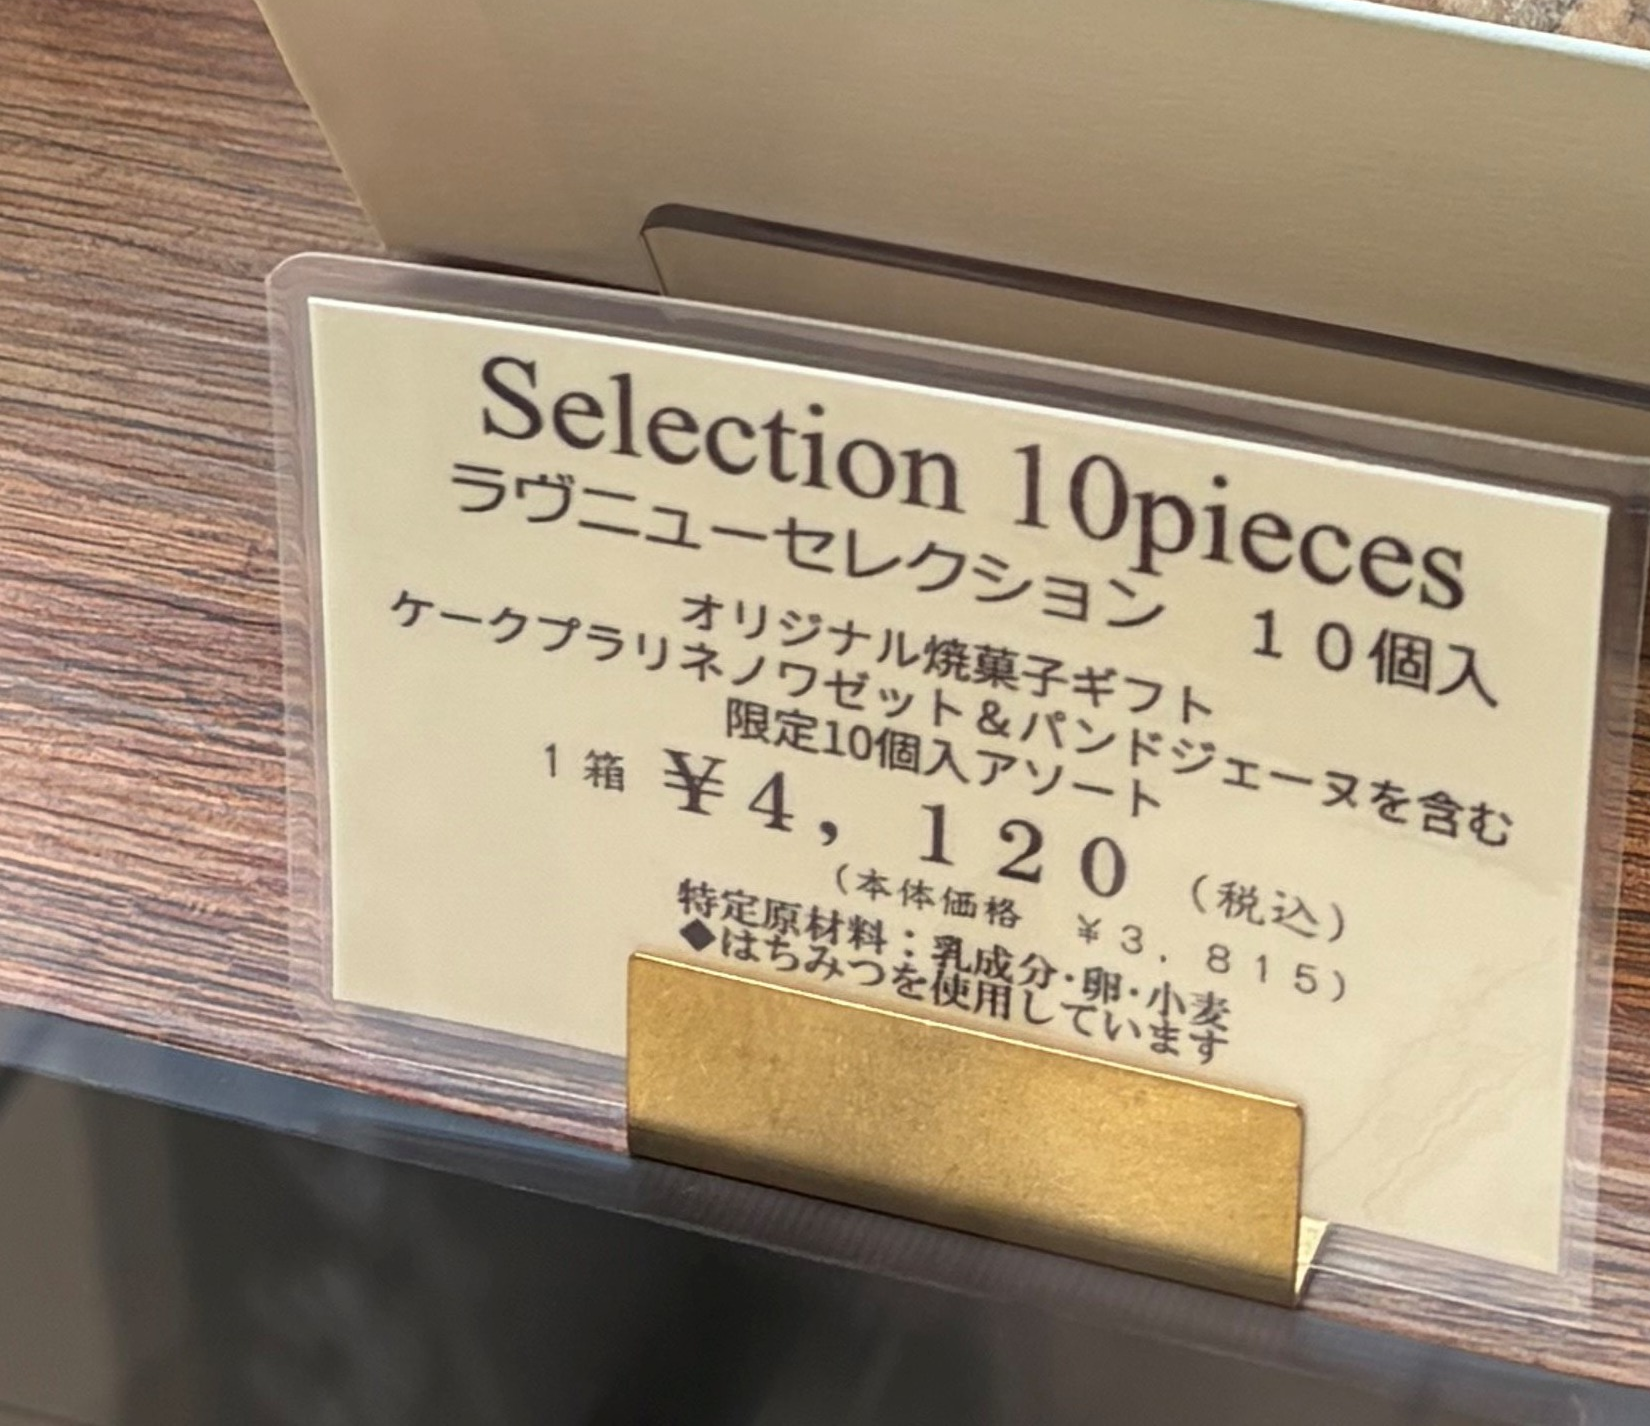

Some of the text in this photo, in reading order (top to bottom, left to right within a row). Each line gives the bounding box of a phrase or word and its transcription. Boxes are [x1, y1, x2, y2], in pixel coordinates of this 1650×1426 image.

[451, 462, 1166, 629] ラヴニューセレクション
[480, 355, 1466, 612] Selection 10pieces
[681, 592, 1213, 725] オリジナル焼菓子ギフト
[726, 696, 1162, 819] 限定10個入アソート
[1190, 874, 1345, 943] (税込)
